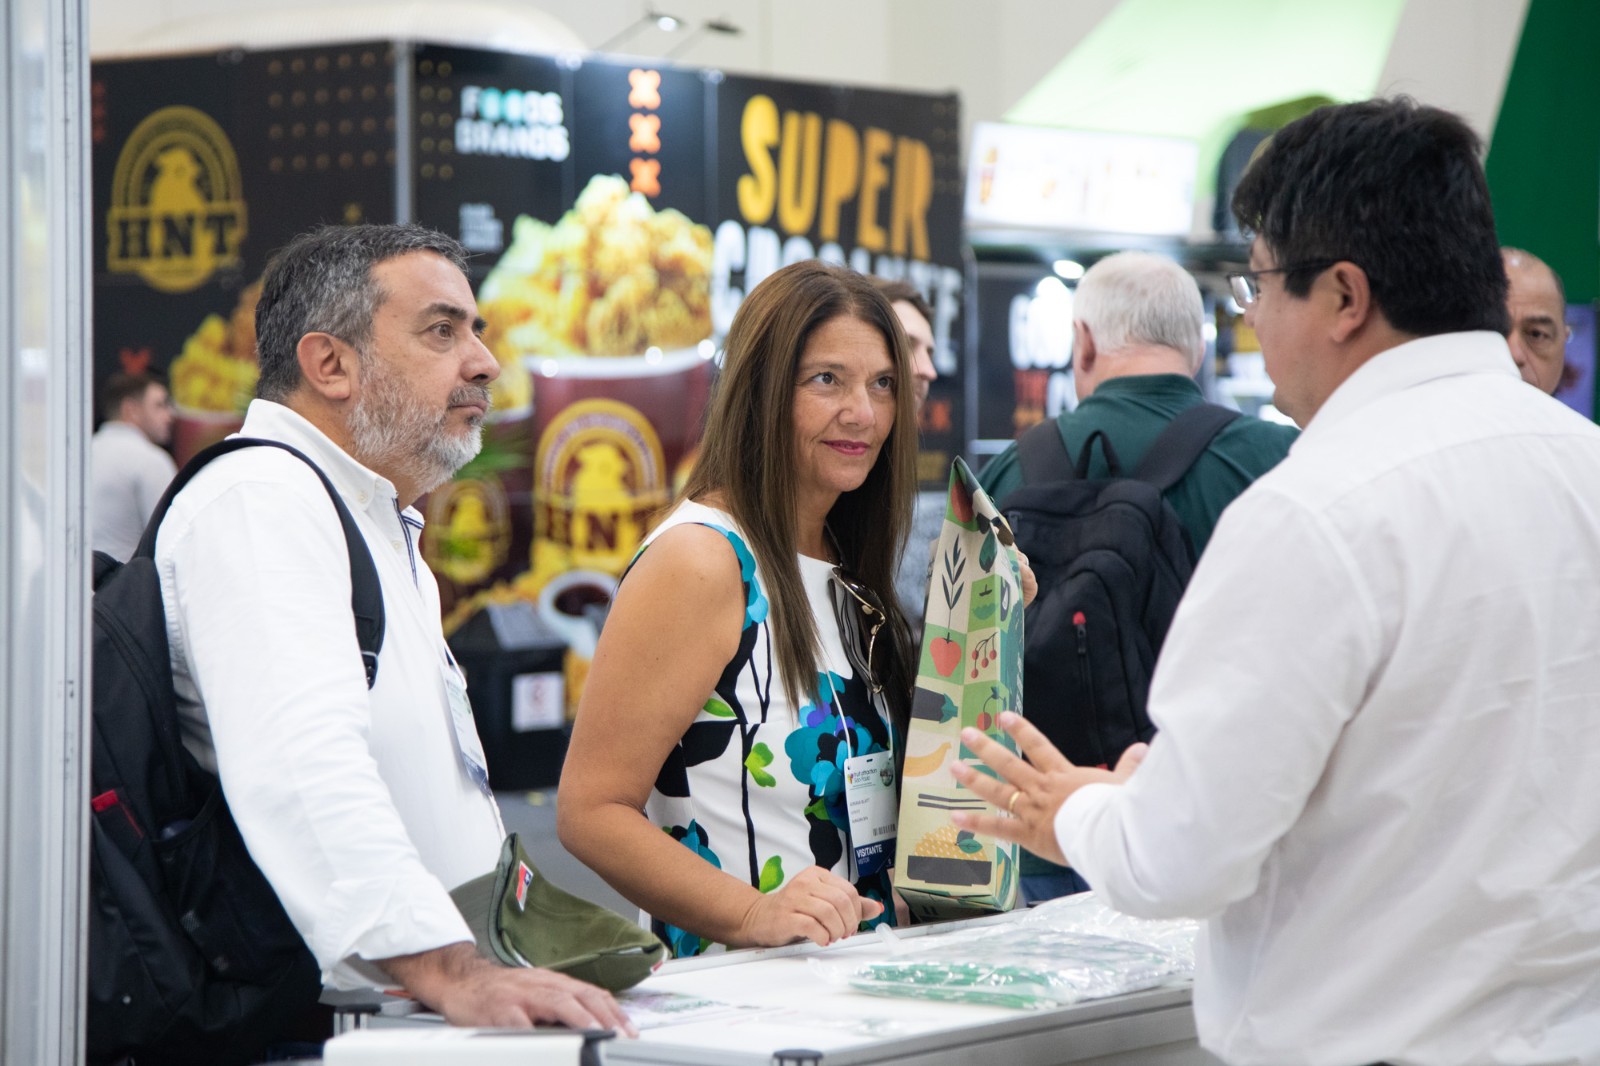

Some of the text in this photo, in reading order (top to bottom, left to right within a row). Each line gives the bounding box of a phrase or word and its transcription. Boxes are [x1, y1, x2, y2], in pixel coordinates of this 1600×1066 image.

[737, 94, 934, 262] SUPER
[118, 212, 238, 260] HNT
[856, 844, 883, 859] VISITANTE
